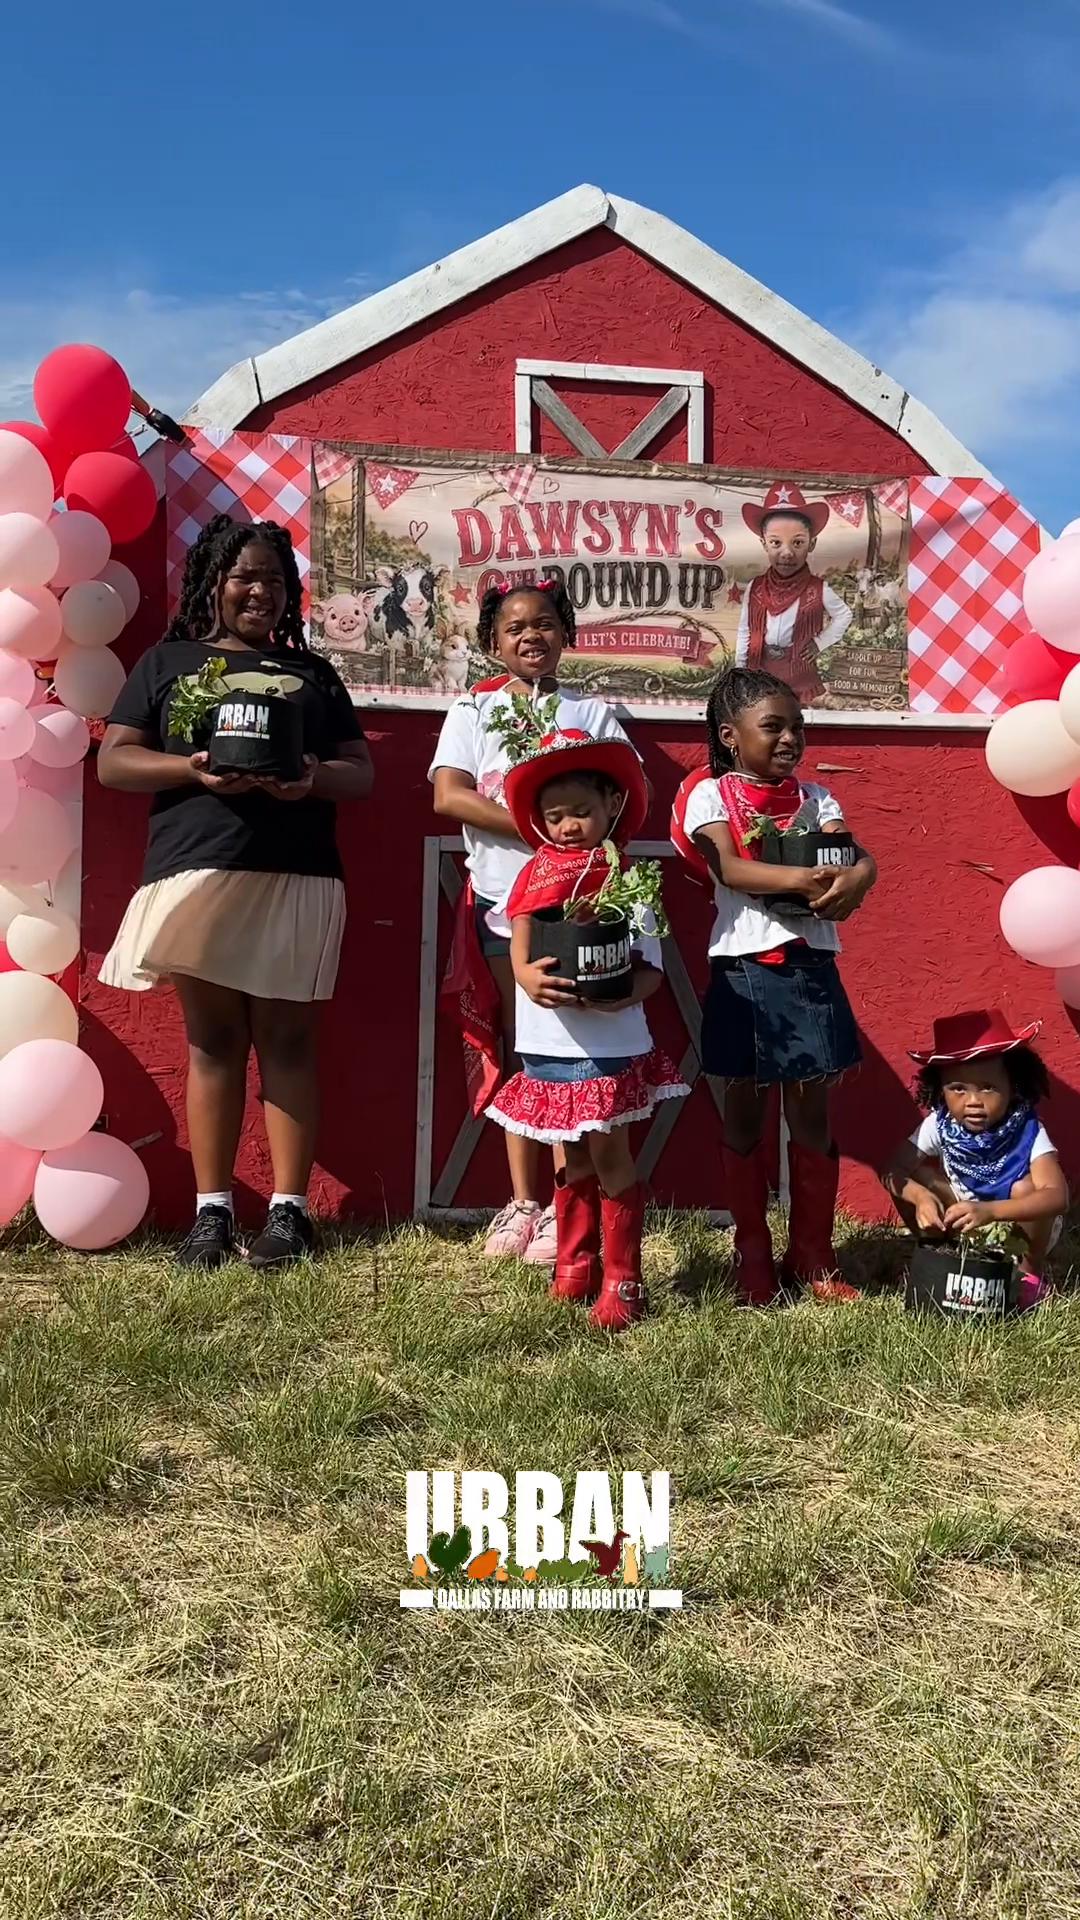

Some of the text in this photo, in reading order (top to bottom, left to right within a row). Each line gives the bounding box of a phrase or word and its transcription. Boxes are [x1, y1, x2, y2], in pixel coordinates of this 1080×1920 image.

[452, 500, 726, 567] DAWSYN'S
[678, 563, 725, 609] UP
[584, 632, 617, 647] LET'S
[621, 632, 691, 650] CELEBRATE!
[834, 680, 851, 689] FOOD
[852, 682, 858, 690] &
